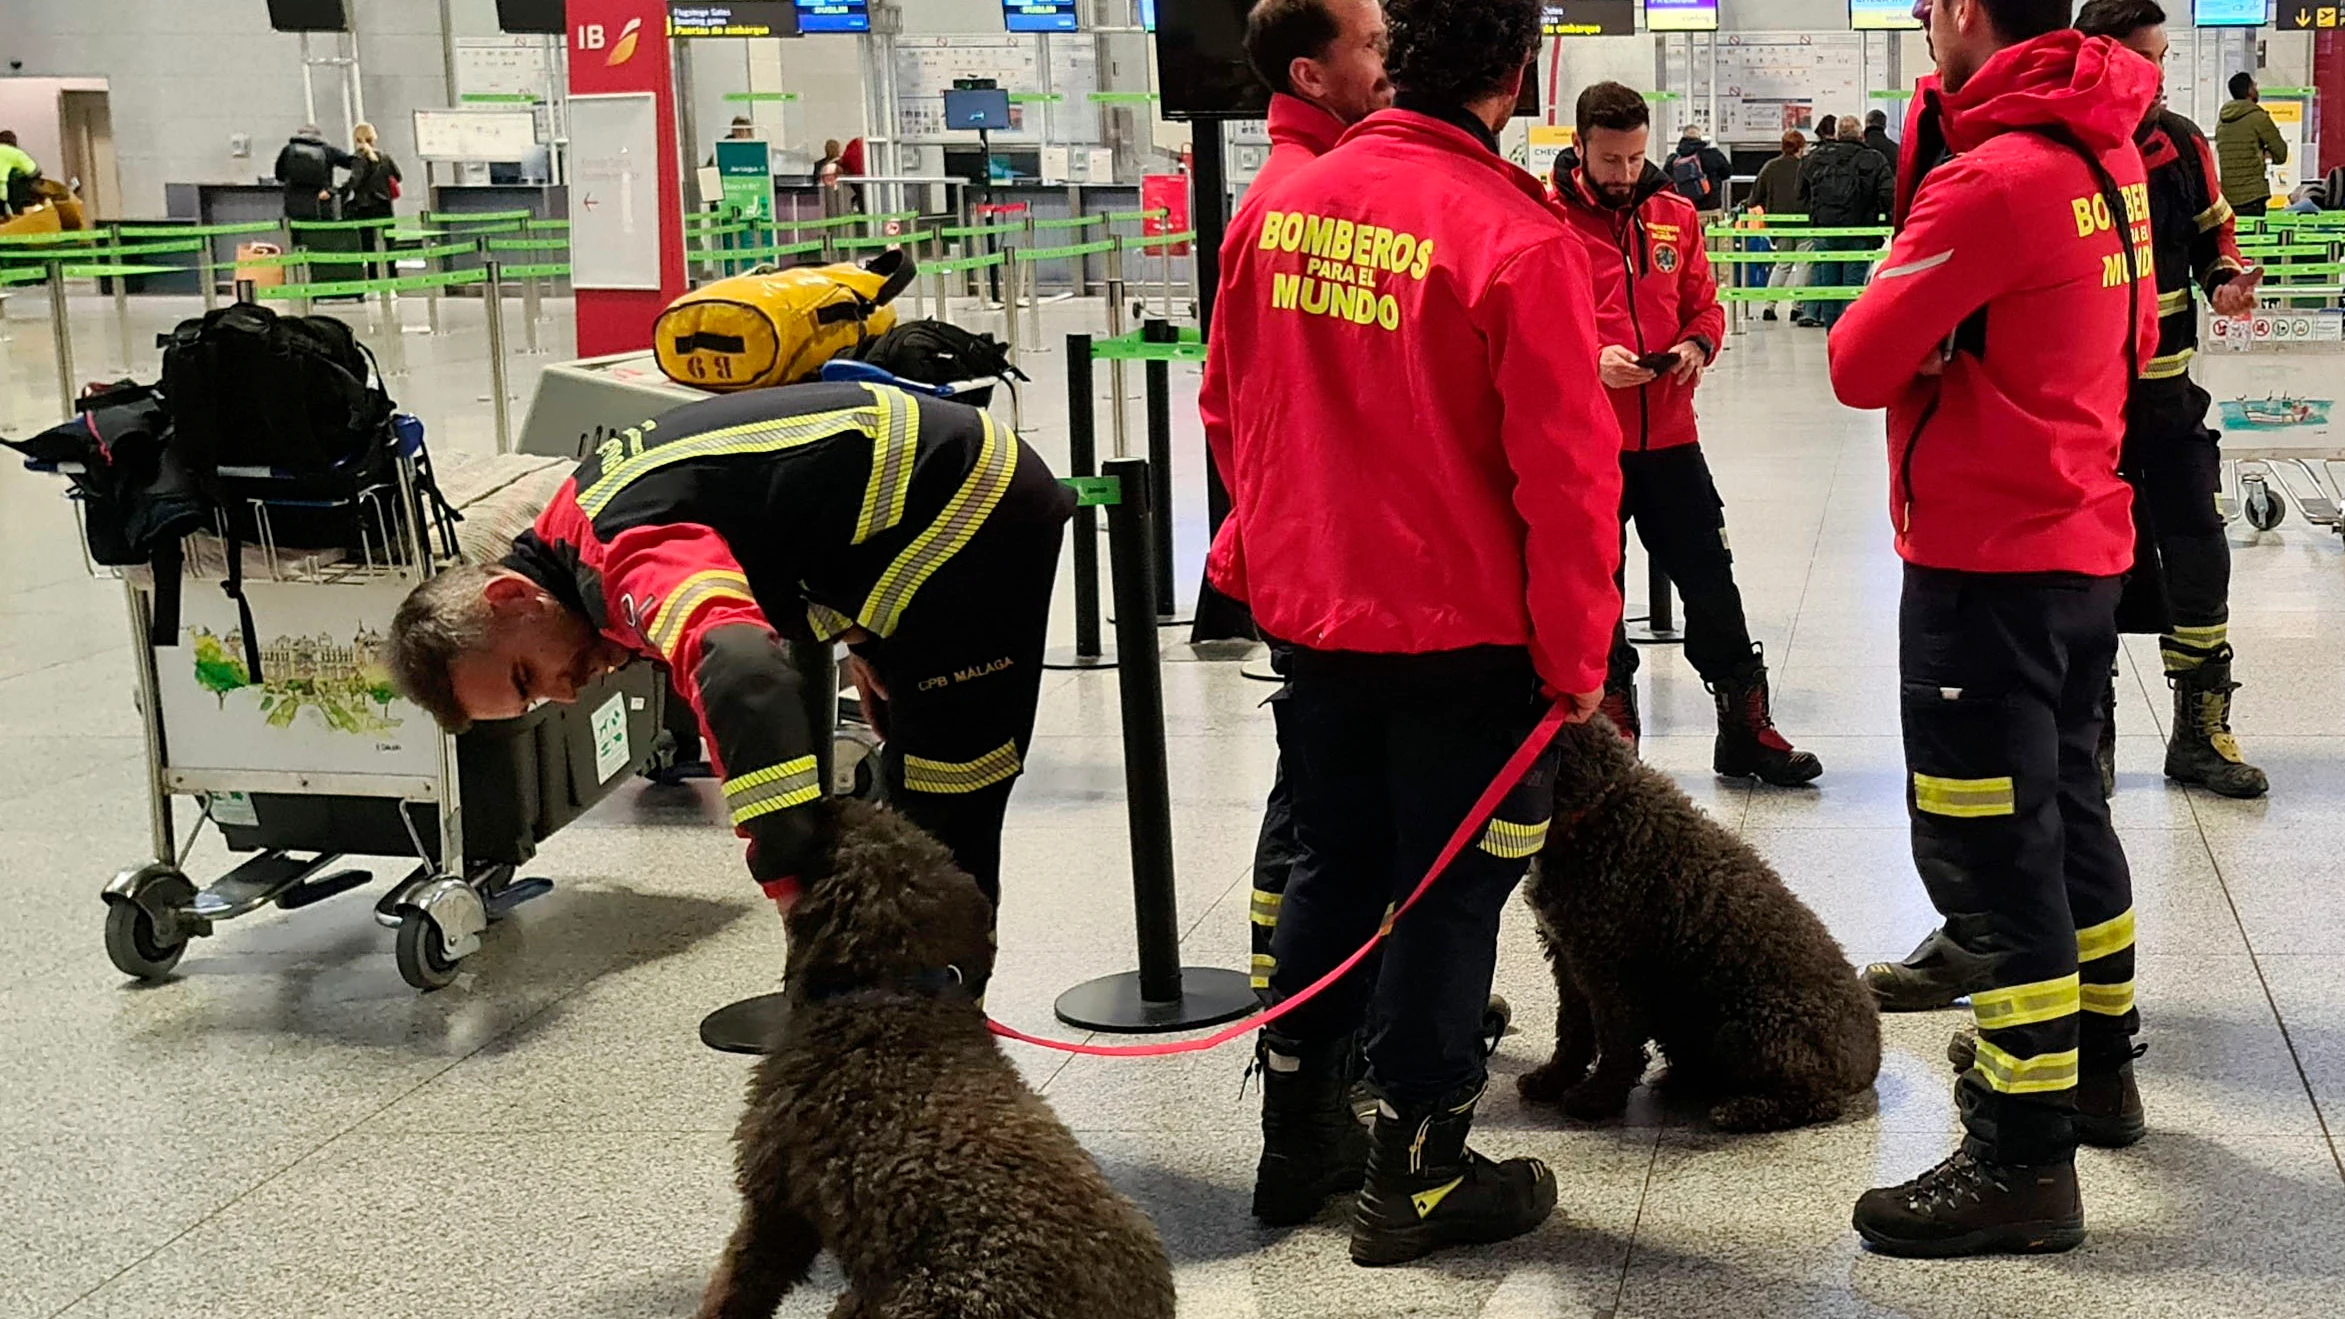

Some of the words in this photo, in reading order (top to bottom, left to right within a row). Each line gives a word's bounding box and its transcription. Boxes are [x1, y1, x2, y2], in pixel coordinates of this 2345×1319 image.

[578, 24, 606, 50] IB
[674, 25, 710, 35] Puertas
[711, 26, 724, 35] de
[724, 25, 770, 36] embarque
[1556, 23, 1602, 36] embarque
[1534, 148, 1561, 157] CHEC
[1258, 210, 1434, 281] BOMBEROS
[1306, 258, 1356, 285] PARA
[1358, 268, 1377, 288] EL
[1272, 273, 1400, 331] MUNDO
[918, 676, 948, 691] CPB
